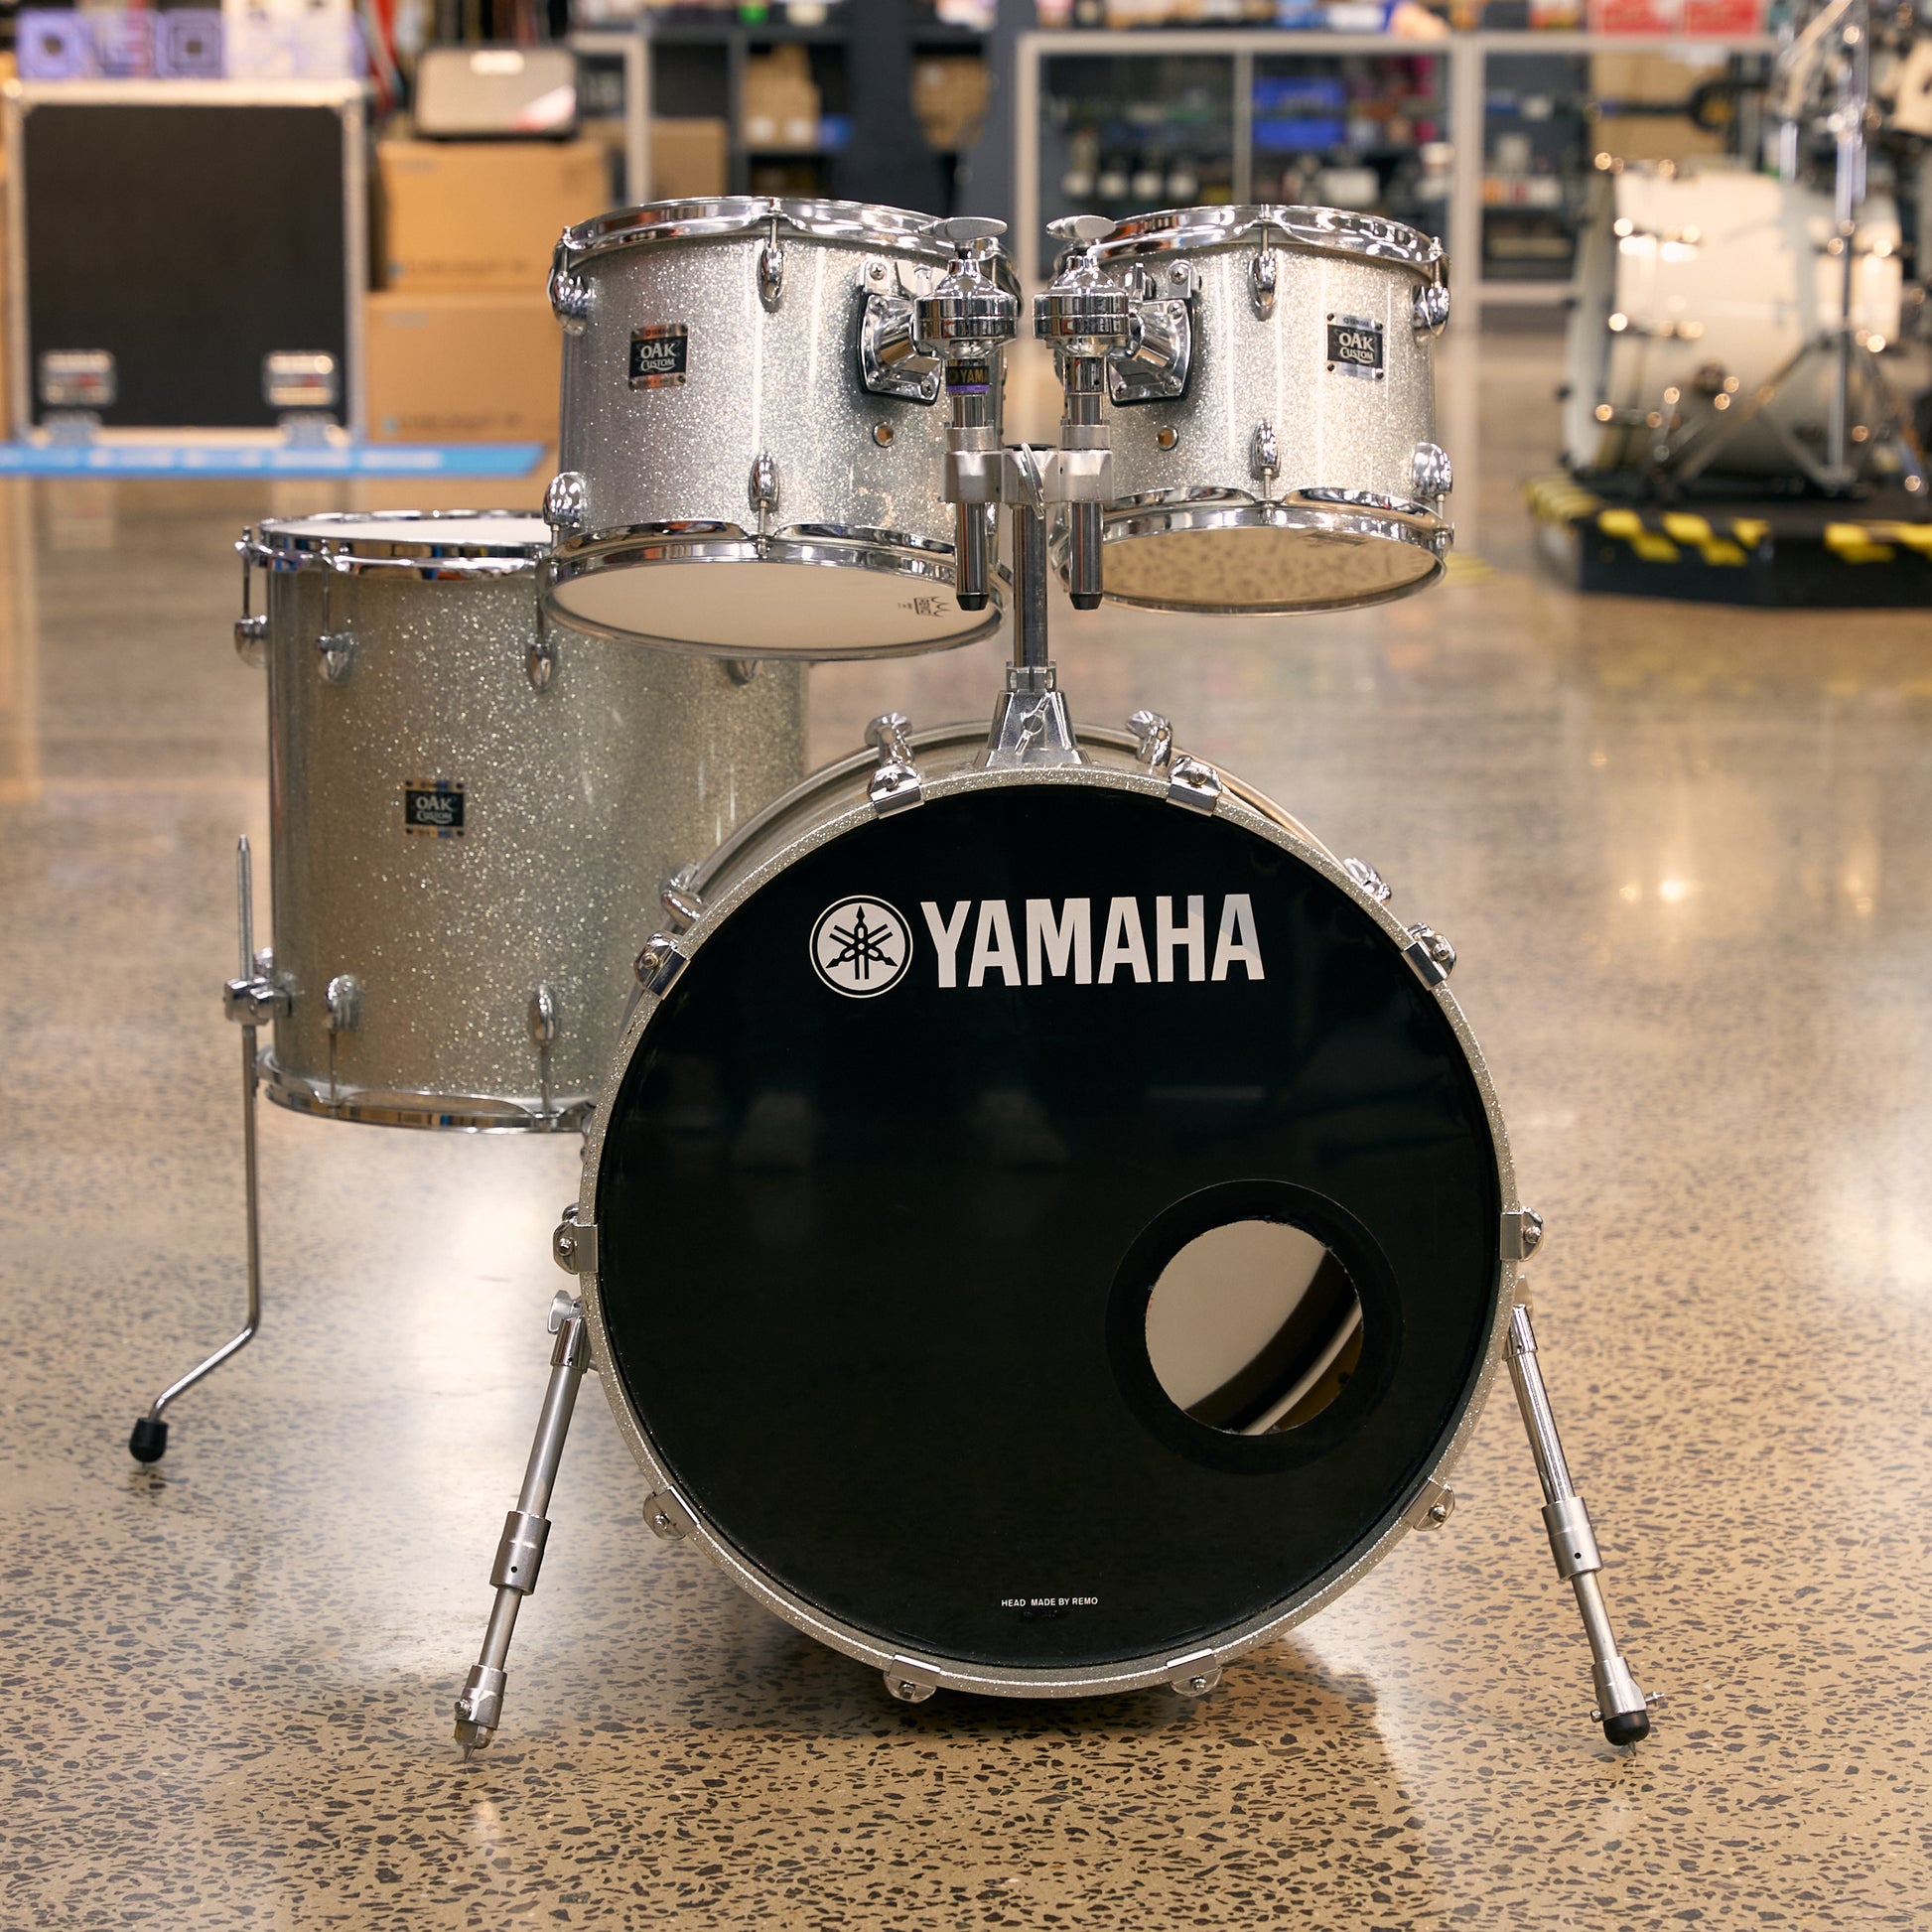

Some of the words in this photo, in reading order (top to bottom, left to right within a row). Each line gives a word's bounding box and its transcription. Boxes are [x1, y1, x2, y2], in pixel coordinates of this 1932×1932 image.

[1338, 332, 1374, 351] OAK
[639, 343, 676, 358] OAK
[416, 795, 453, 812] OAK
[920, 894, 1265, 988] YAMAHA
[1071, 1596, 1098, 1605] REMO
